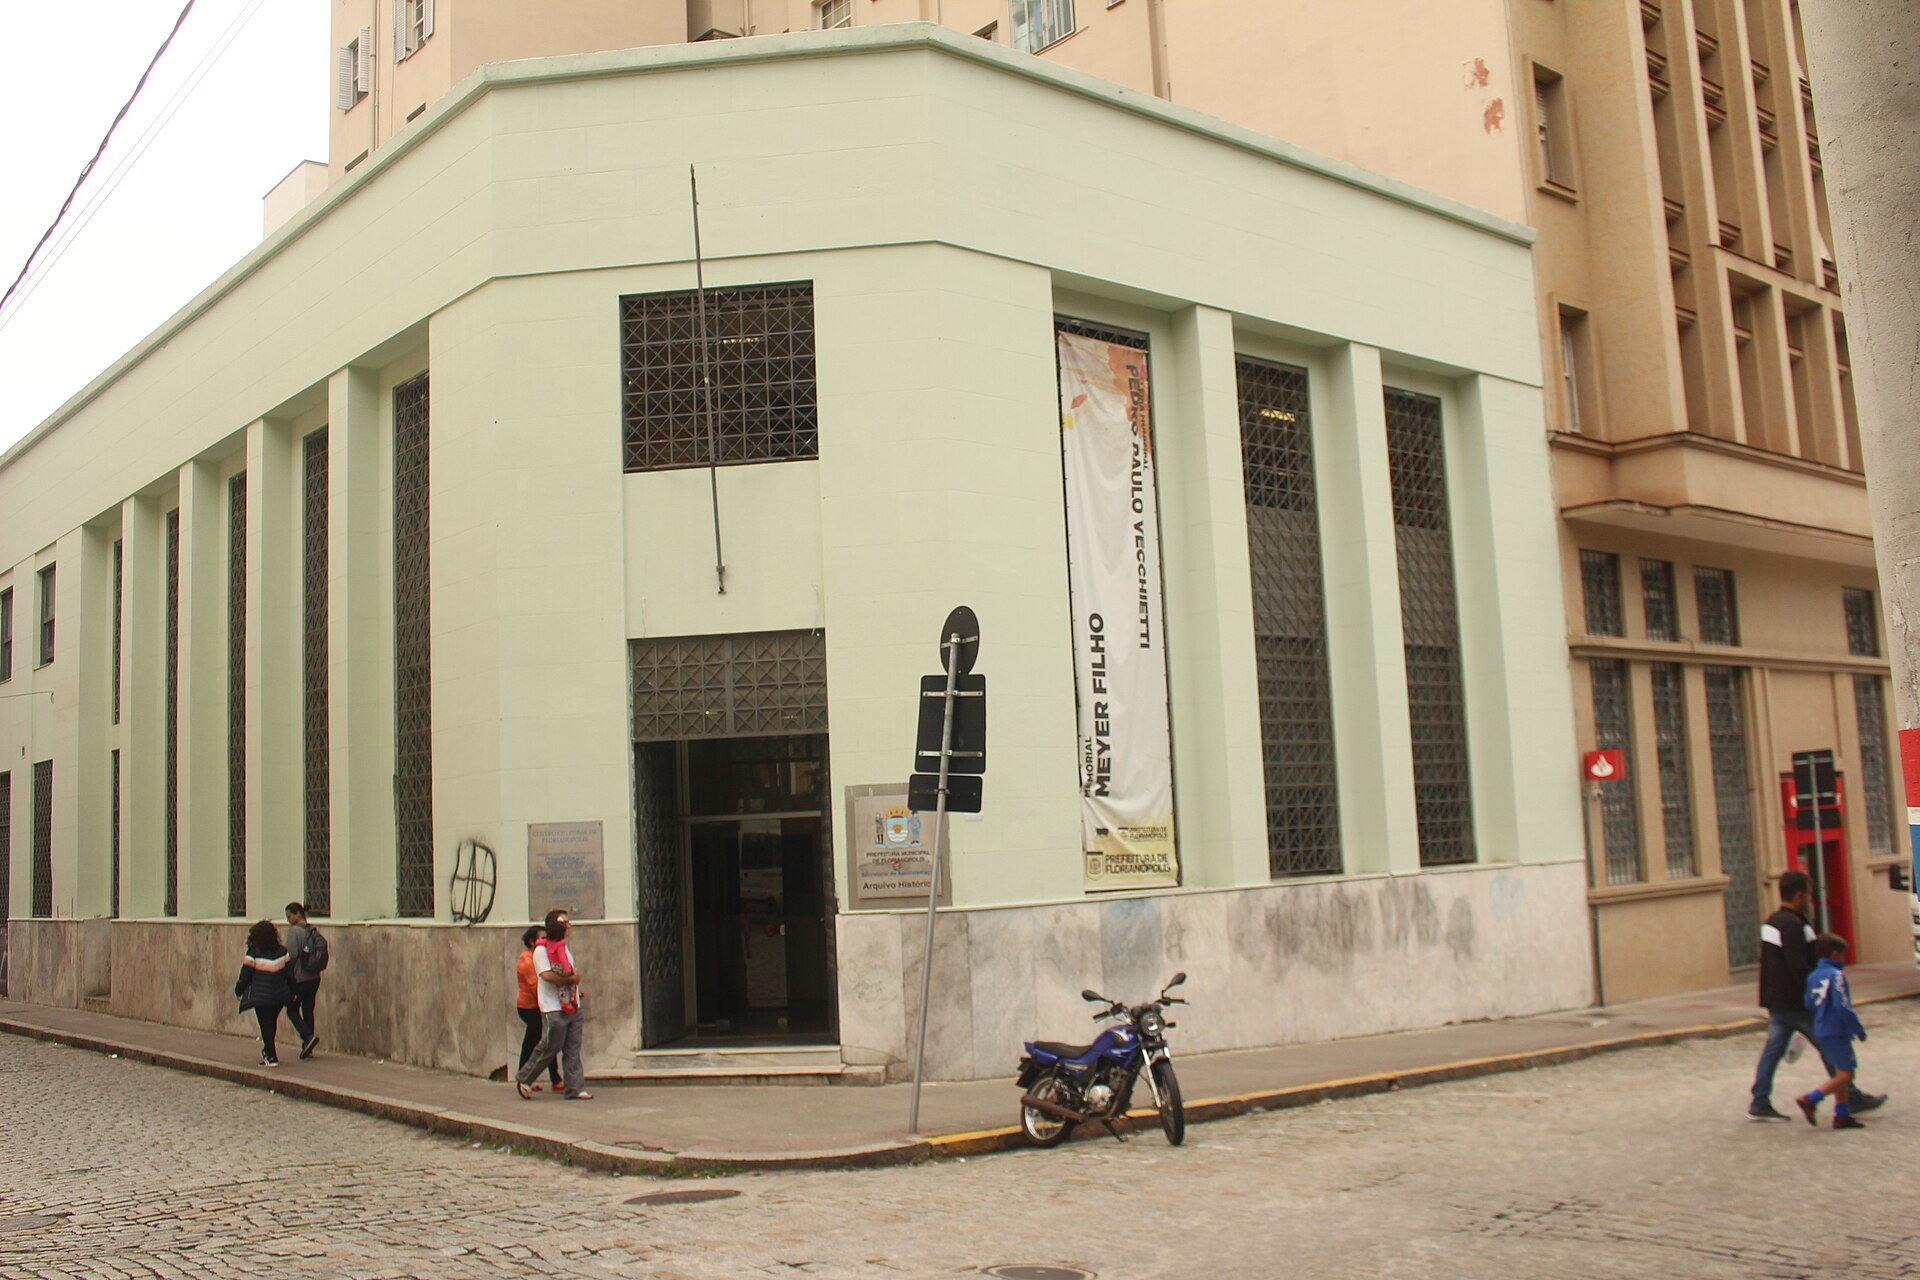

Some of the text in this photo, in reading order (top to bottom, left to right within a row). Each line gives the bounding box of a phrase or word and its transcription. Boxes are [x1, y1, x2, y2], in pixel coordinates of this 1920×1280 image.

[1133, 520, 1150, 649] VECCHIETTI
[1088, 613, 1111, 797] MEYER FILHO
[1084, 736, 1094, 798] MEMORIAL
[863, 880, 931, 890] Arquivo Históric
[1105, 853, 1168, 864] PREFEITURA DE
